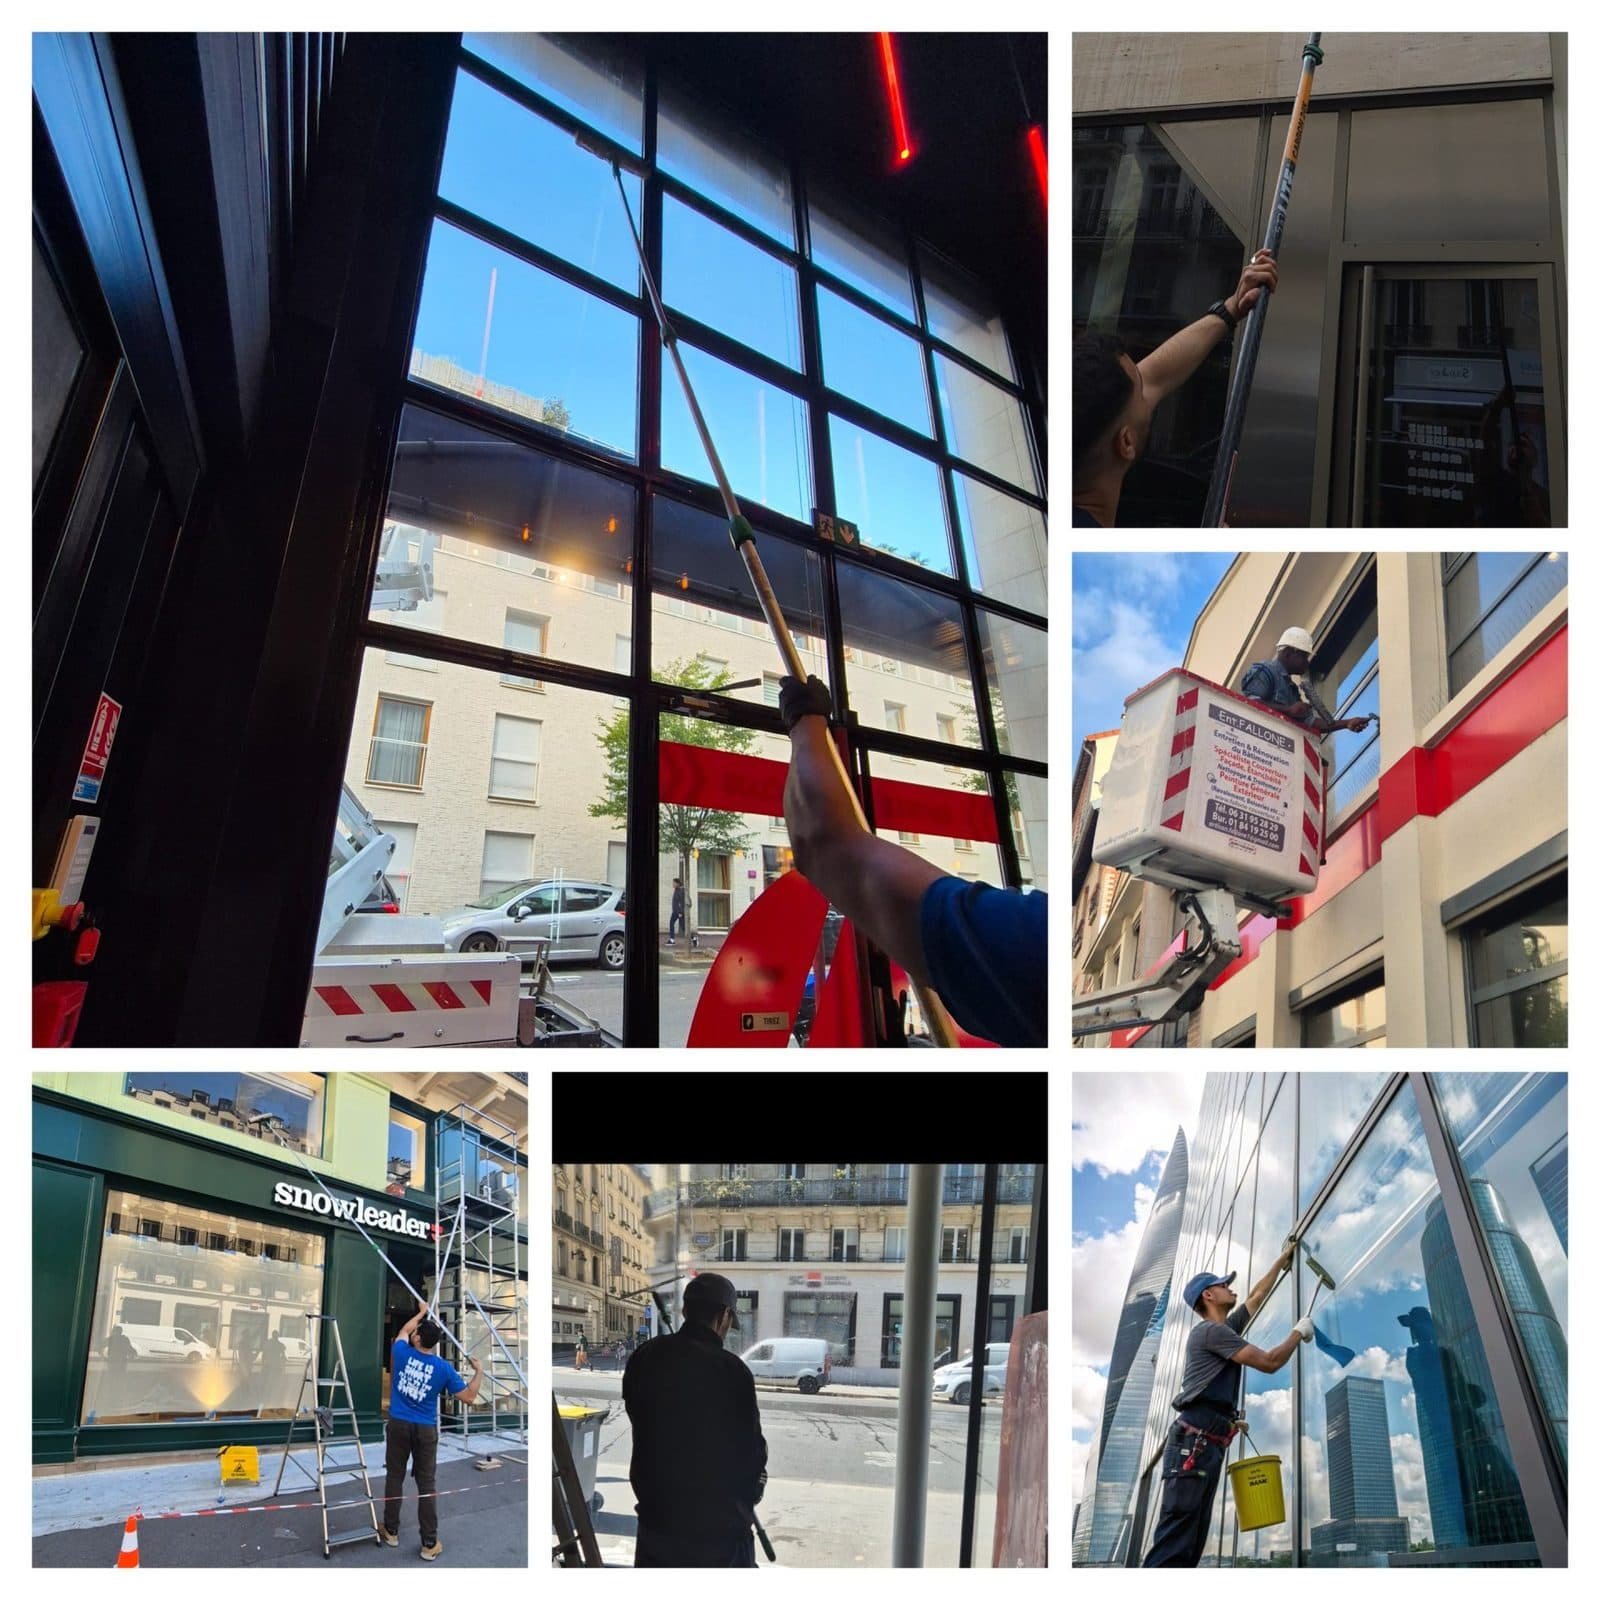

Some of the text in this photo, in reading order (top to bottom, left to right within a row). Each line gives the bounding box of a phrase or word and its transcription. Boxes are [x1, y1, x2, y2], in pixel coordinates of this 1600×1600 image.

[1214, 729, 1246, 749] Entretien
[1253, 744, 1289, 766] Rénovation
[1232, 745, 1272, 766] du Bâtiment
[1214, 745, 1287, 780] Spécialiste Couverture
[1217, 762, 1246, 780] Nettoyage
[1219, 771, 1280, 800] Peinture Générale
[1232, 784, 1264, 802] Extérieur
[1214, 802, 1278, 831] Tél. 06 31 95 28 29
[1250, 825, 1258, 835] 19
[1259, 828, 1268, 838] 25
[1269, 832, 1278, 841] 00
[274, 1181, 430, 1239] snowleader
[408, 1356, 424, 1370] LIFE
